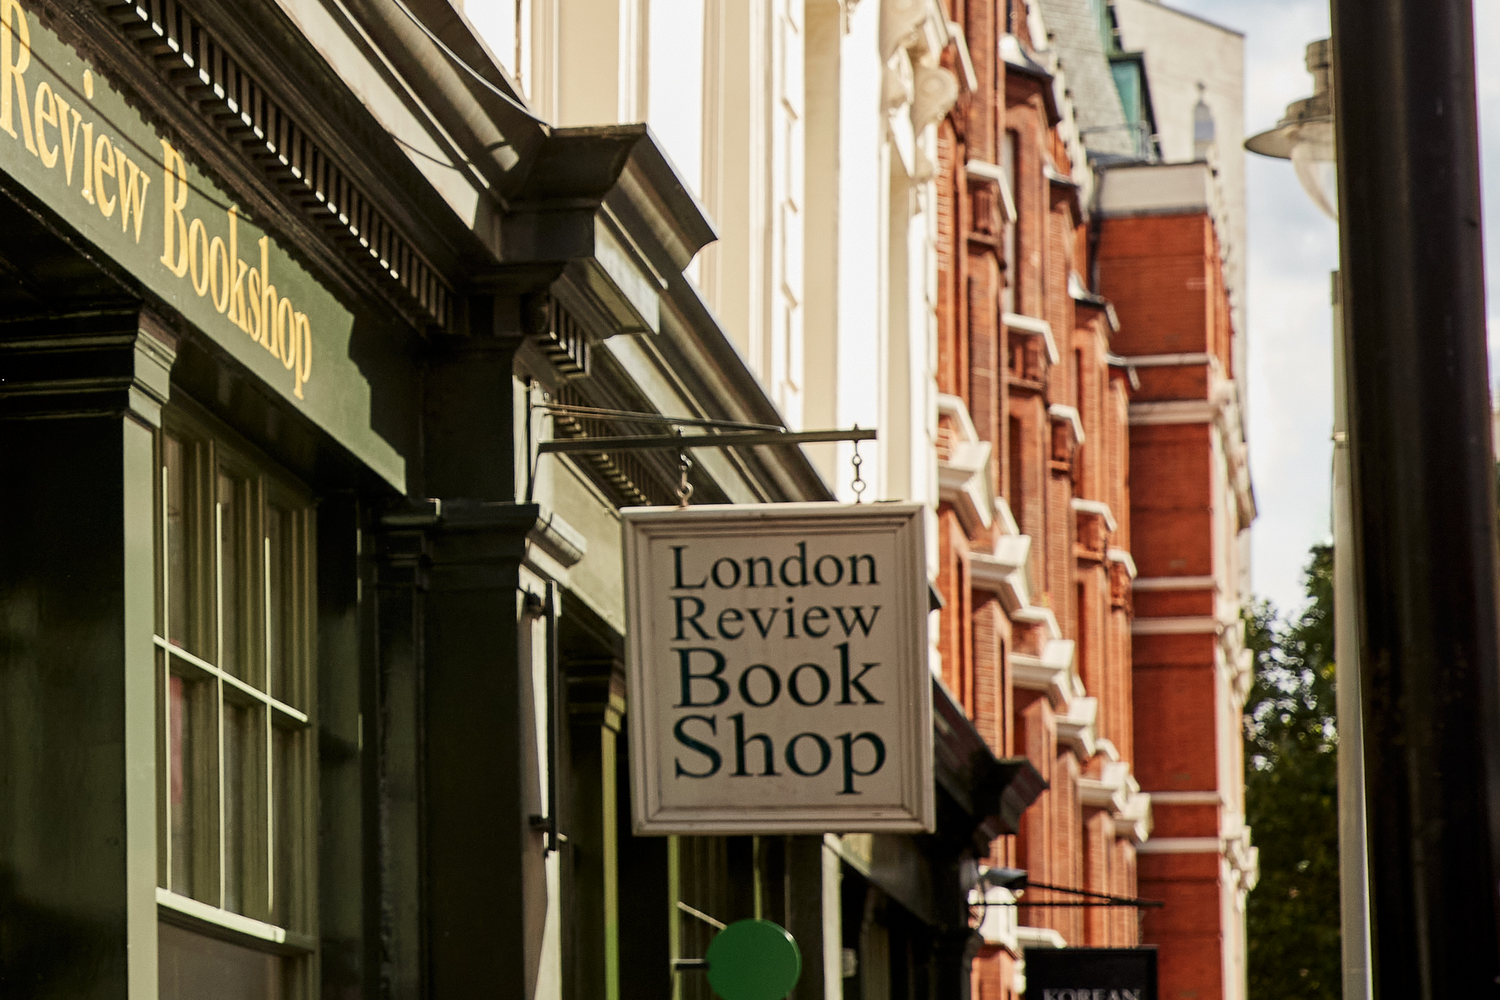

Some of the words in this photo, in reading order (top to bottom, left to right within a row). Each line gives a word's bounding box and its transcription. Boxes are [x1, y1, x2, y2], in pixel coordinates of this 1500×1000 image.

[159, 137, 313, 401] Bookshop
[669, 541, 880, 590] London
[669, 595, 882, 641] Review
[671, 641, 885, 709] Book
[673, 712, 887, 796] Shop
